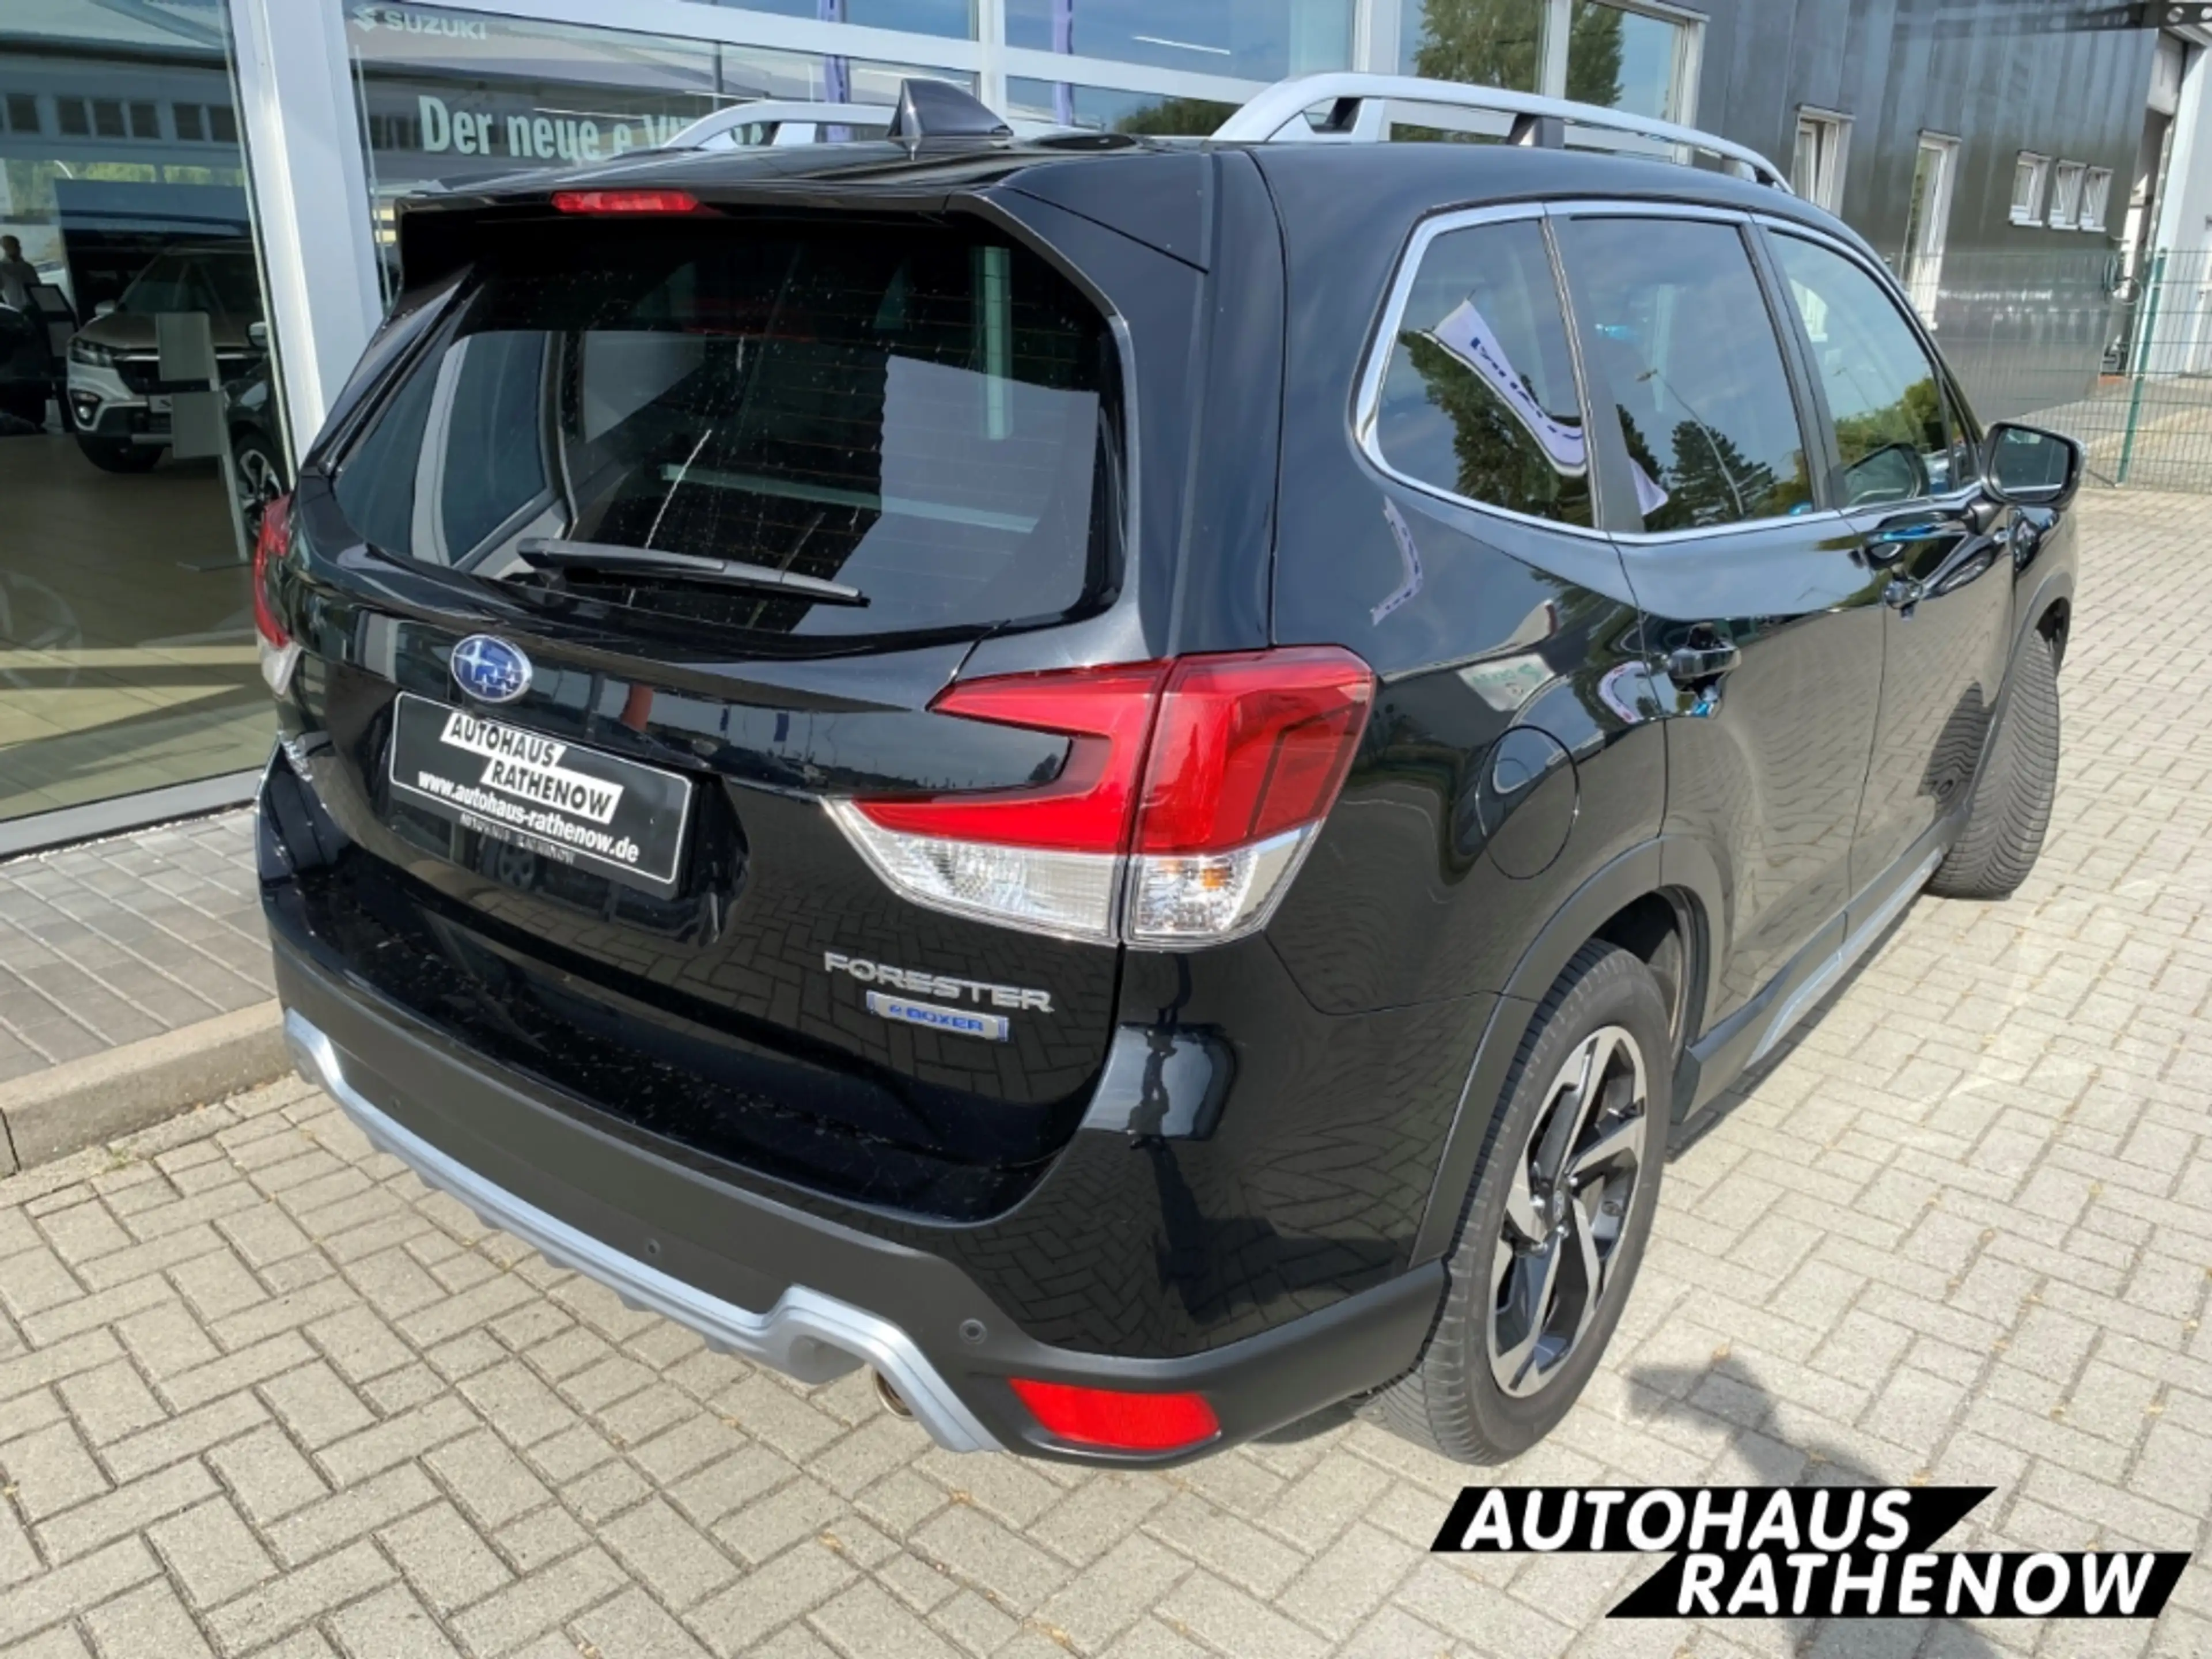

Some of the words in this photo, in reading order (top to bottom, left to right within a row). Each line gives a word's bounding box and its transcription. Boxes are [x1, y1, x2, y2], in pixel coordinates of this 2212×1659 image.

[384, 10, 486, 40] SUZUKI
[419, 96, 493, 155] Der
[508, 115, 600, 161] neue
[450, 718, 556, 761] AUTOHAUS
[418, 771, 639, 863] www.autohaus-rathenow.de
[491, 761, 613, 817] RATHENOW
[824, 952, 1055, 1012] FORESTER
